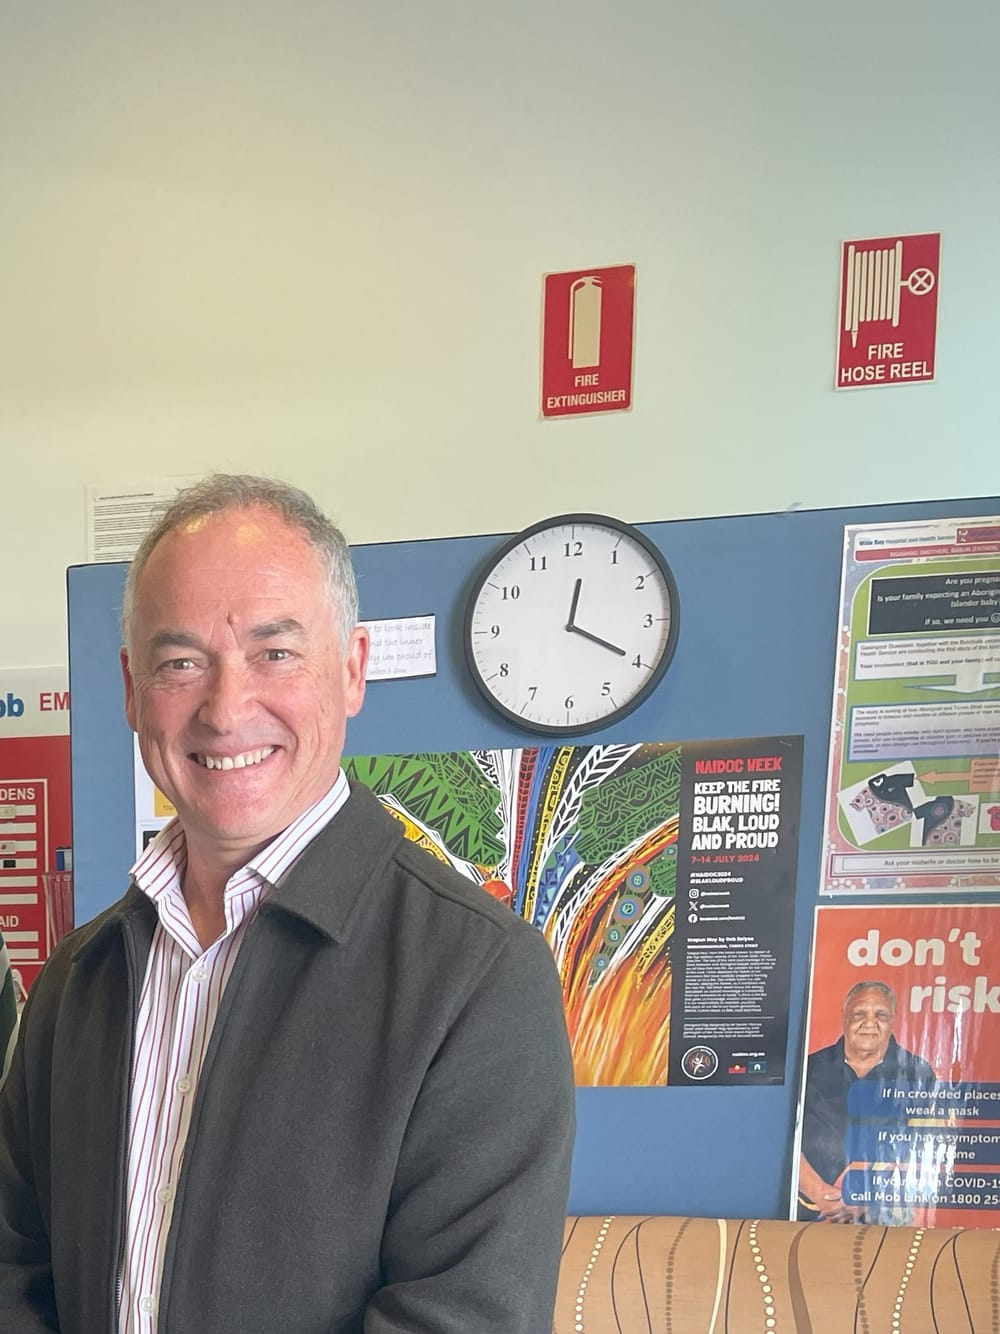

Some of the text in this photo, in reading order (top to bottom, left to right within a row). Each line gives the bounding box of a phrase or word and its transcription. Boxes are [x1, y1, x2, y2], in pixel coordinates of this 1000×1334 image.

[868, 342, 904, 360] FIRE
[841, 360, 932, 382] HOSE REEL
[574, 373, 599, 387] FIRE
[546, 389, 626, 408] EXTINGUISHER
[563, 542, 583, 557] 12
[529, 556, 547, 571] 11
[610, 550, 618, 564] 1
[635, 575, 645, 590] 2
[501, 586, 520, 600] 10
[885, 594, 901, 604] your
[902, 593, 924, 602] family
[925, 591, 960, 600] expecting
[951, 598, 997, 608] Islander baby
[643, 614, 653, 628] 3
[956, 616, 974, 624] need
[975, 616, 989, 624] you
[491, 625, 500, 638] 9
[632, 654, 641, 668] 4
[500, 663, 509, 677] 8
[528, 687, 537, 700] 7
[601, 682, 611, 696] 5
[565, 696, 574, 709] 6
[695, 756, 782, 774] NAIDOC WEEK
[694, 779, 781, 794] KEEP THE FIRE
[693, 793, 780, 815] BURNING!
[692, 814, 779, 834] BLAK, LOUD
[691, 832, 779, 850] AND PROUD
[713, 855, 735, 863] JULY
[737, 854, 760, 863] 2024
[847, 928, 982, 966] don't
[910, 976, 1000, 1014] risk
[882, 1088, 891, 1098] If
[894, 1088, 905, 1098] in
[908, 1089, 961, 1099] crowded
[905, 1106, 980, 1116] wear a mask
[878, 1131, 887, 1141] If
[889, 1132, 911, 1144] you
[915, 1132, 942, 1142] have
[945, 1177, 1000, 1189] COVID-1
[851, 1191, 871, 1201] call
[875, 1191, 900, 1201] Mob
[931, 1193, 947, 1203] on
[951, 1194, 981, 1204] 1800
[984, 1195, 1000, 1205] 25
